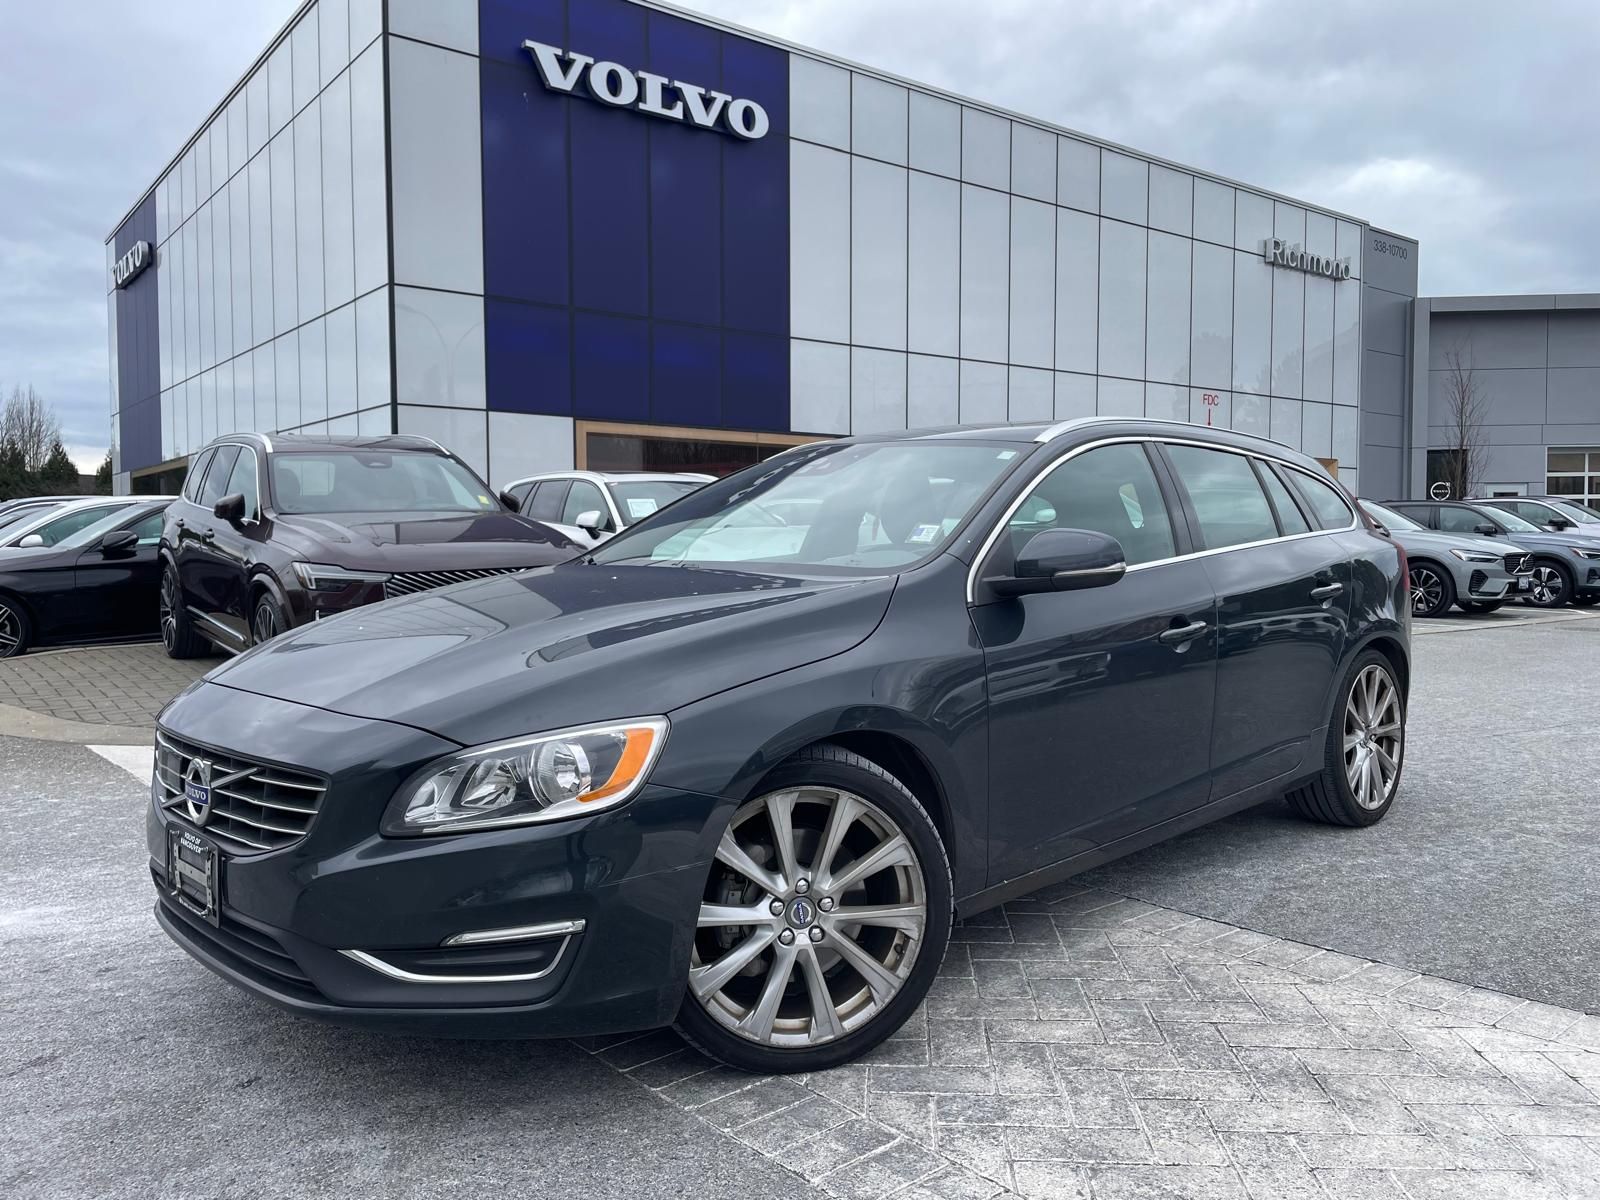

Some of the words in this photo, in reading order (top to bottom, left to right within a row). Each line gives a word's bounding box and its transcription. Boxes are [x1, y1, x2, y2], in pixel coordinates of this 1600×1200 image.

[522, 39, 770, 139] VOLVO
[1265, 238, 1350, 280] Richmond
[1373, 239, 1408, 260] 338-10700
[1203, 393, 1219, 406] FDC
